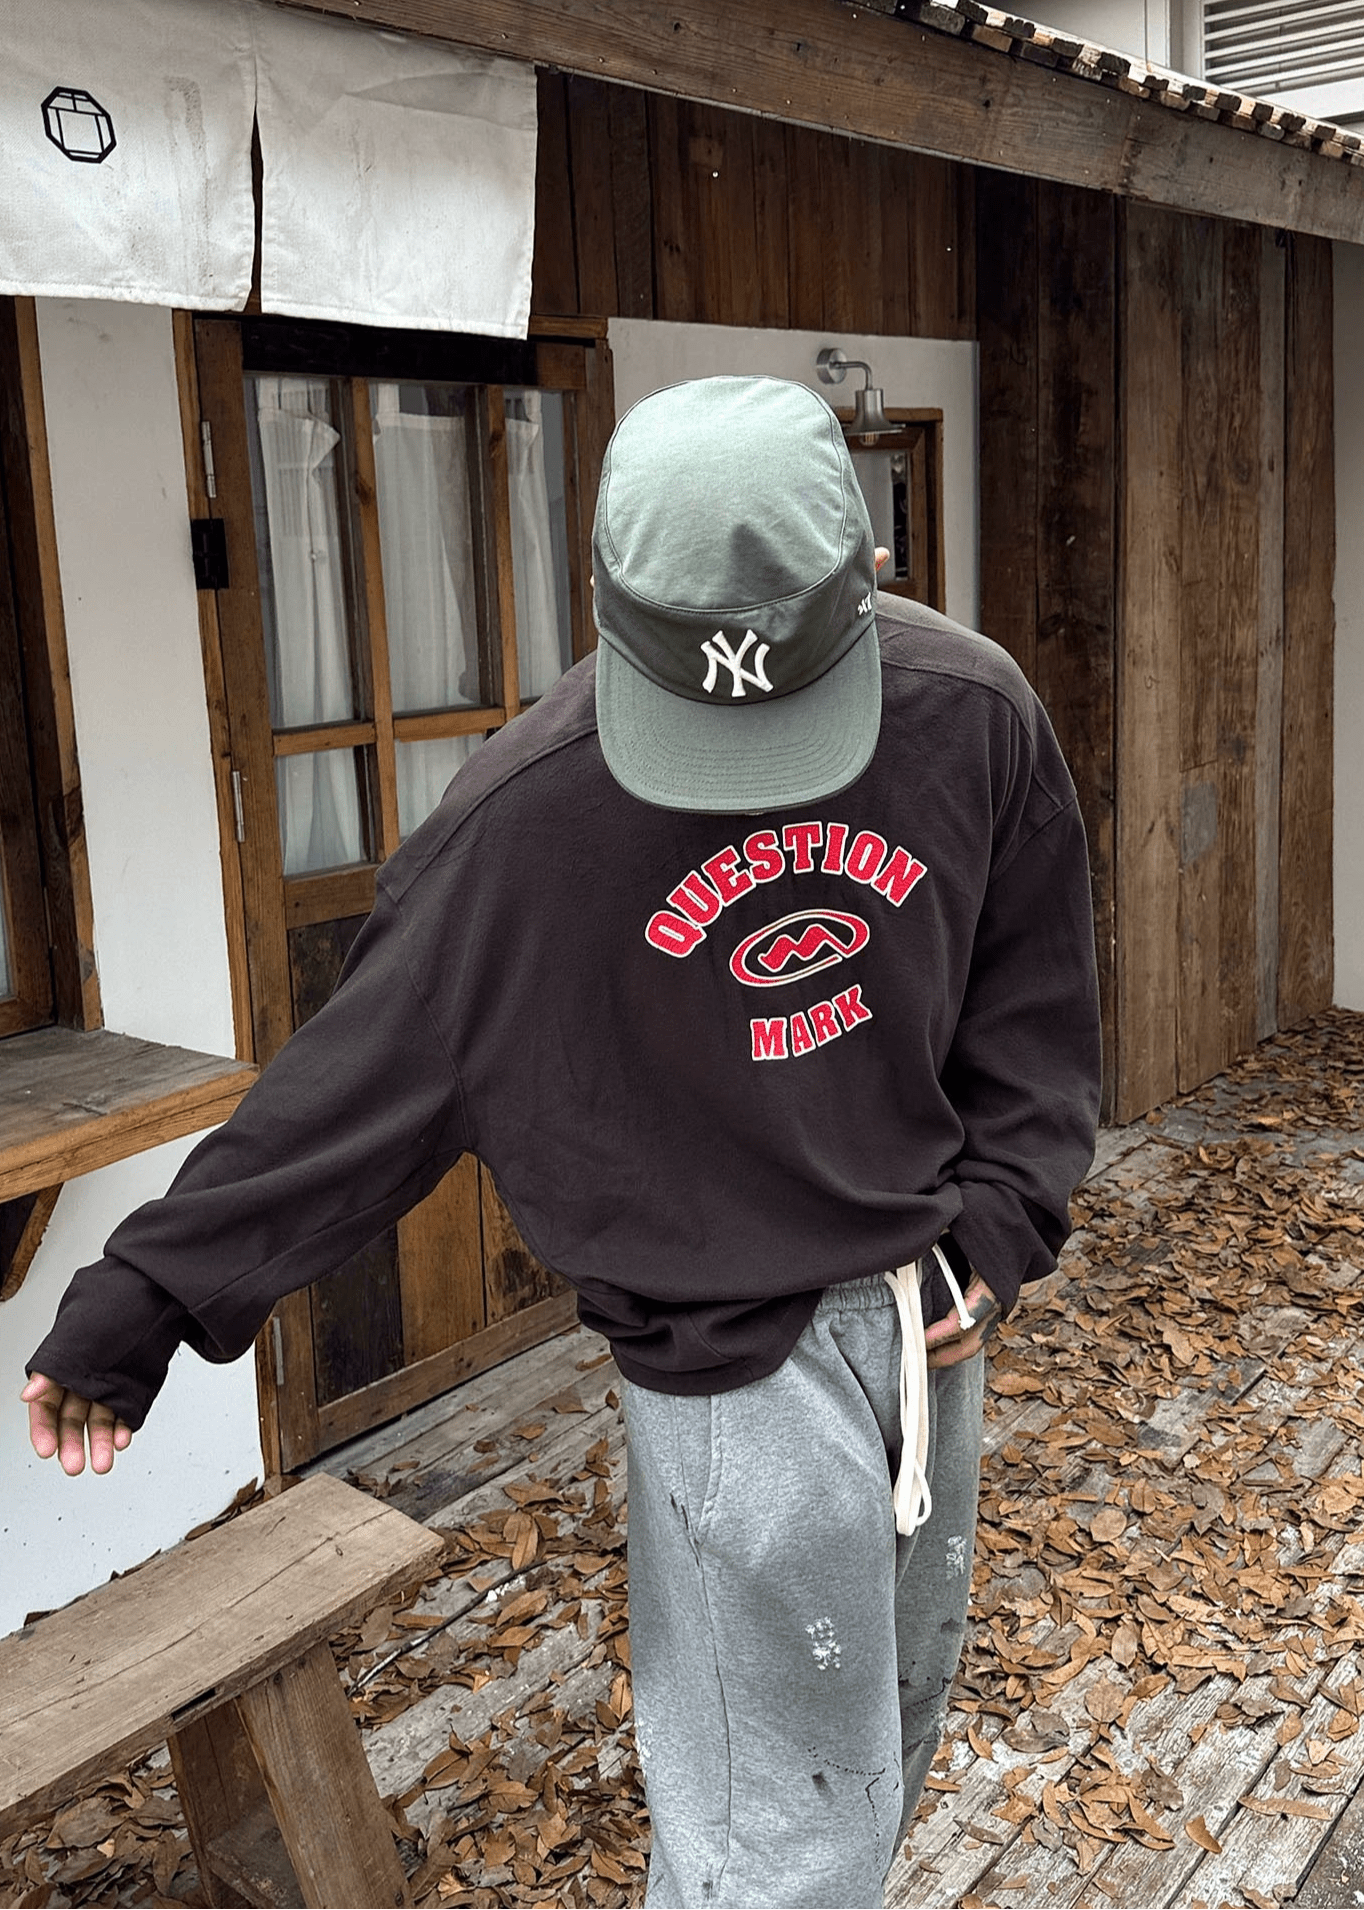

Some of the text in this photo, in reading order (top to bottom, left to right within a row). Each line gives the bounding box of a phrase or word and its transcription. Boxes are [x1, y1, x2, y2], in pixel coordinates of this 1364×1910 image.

[700, 629, 774, 698] NY
[645, 821, 928, 958] QUESTION
[750, 983, 873, 1061] MARK
